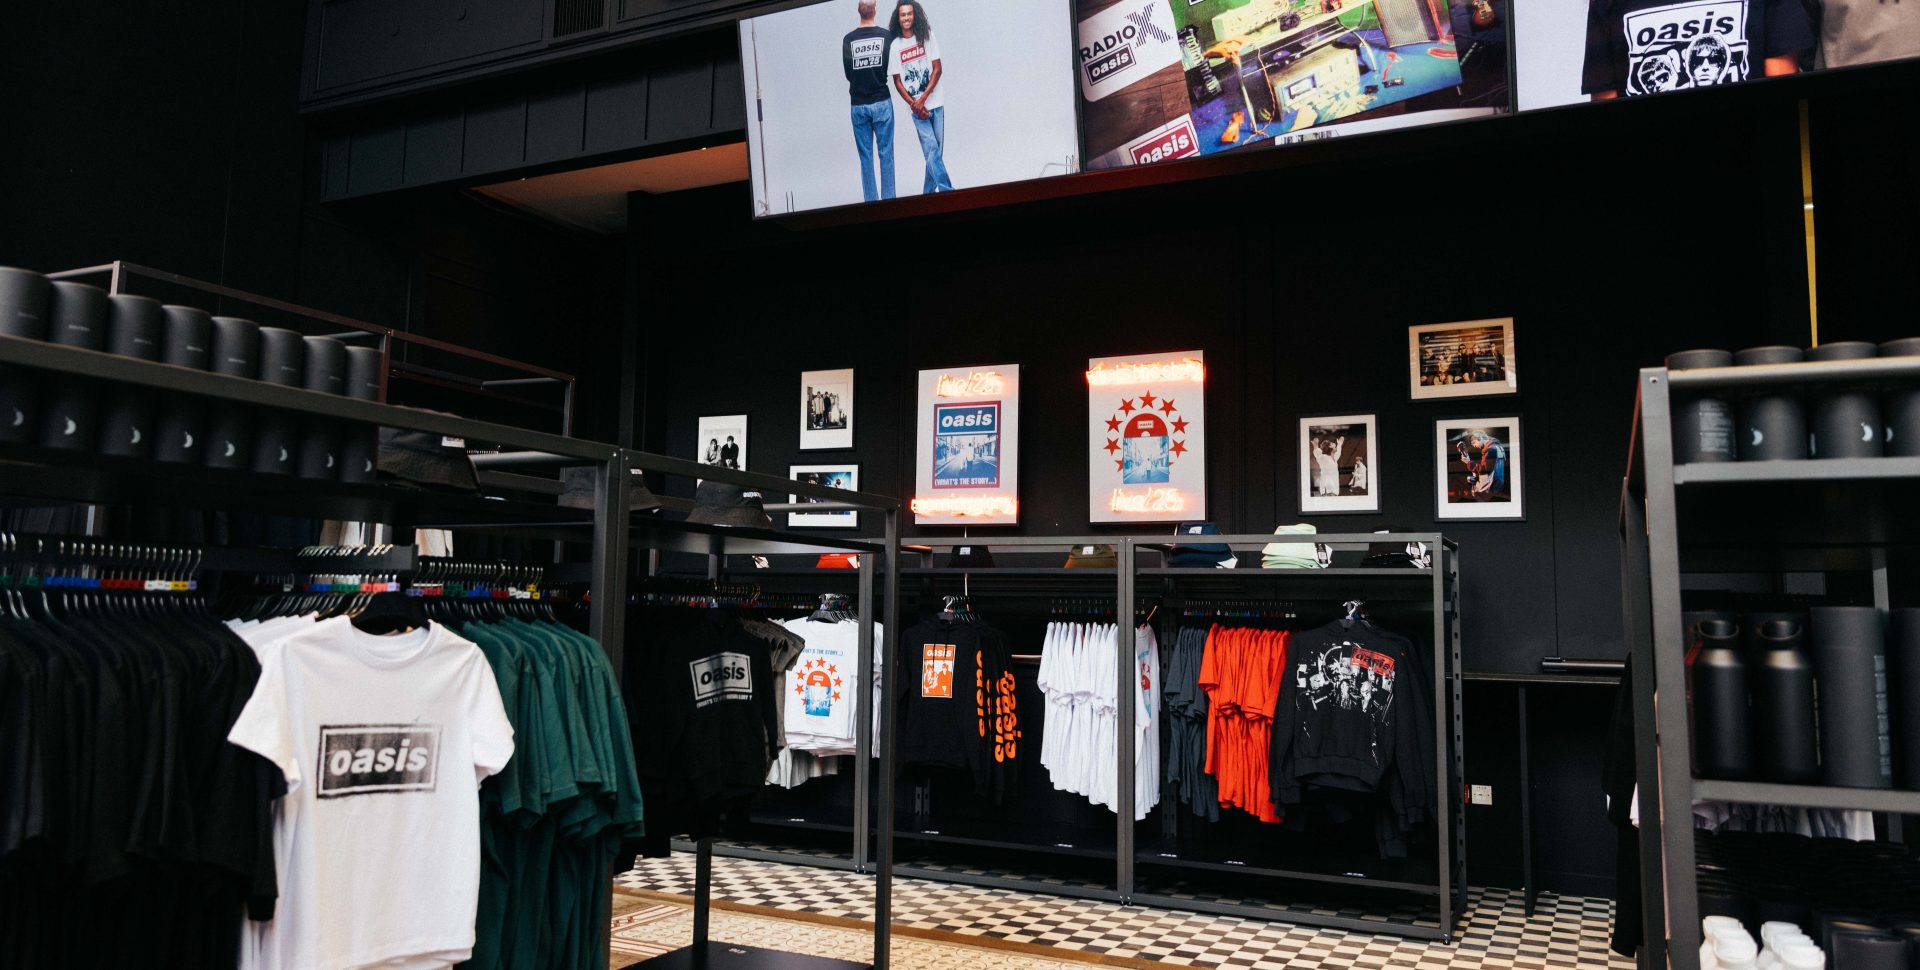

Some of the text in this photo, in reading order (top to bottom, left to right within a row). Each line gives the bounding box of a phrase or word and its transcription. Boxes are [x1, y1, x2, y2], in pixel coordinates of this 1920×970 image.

[1079, 3, 1173, 63] RADIO X
[1636, 11, 1735, 47] oasis
[854, 41, 881, 54] oasis
[901, 45, 925, 60] oasis
[1091, 51, 1130, 78] oasis
[1139, 133, 1190, 163] oasis
[941, 410, 993, 428] oasis
[959, 478, 970, 486] THE
[926, 649, 952, 657] oasis
[700, 661, 746, 686] oasis
[329, 738, 429, 777] oasis
